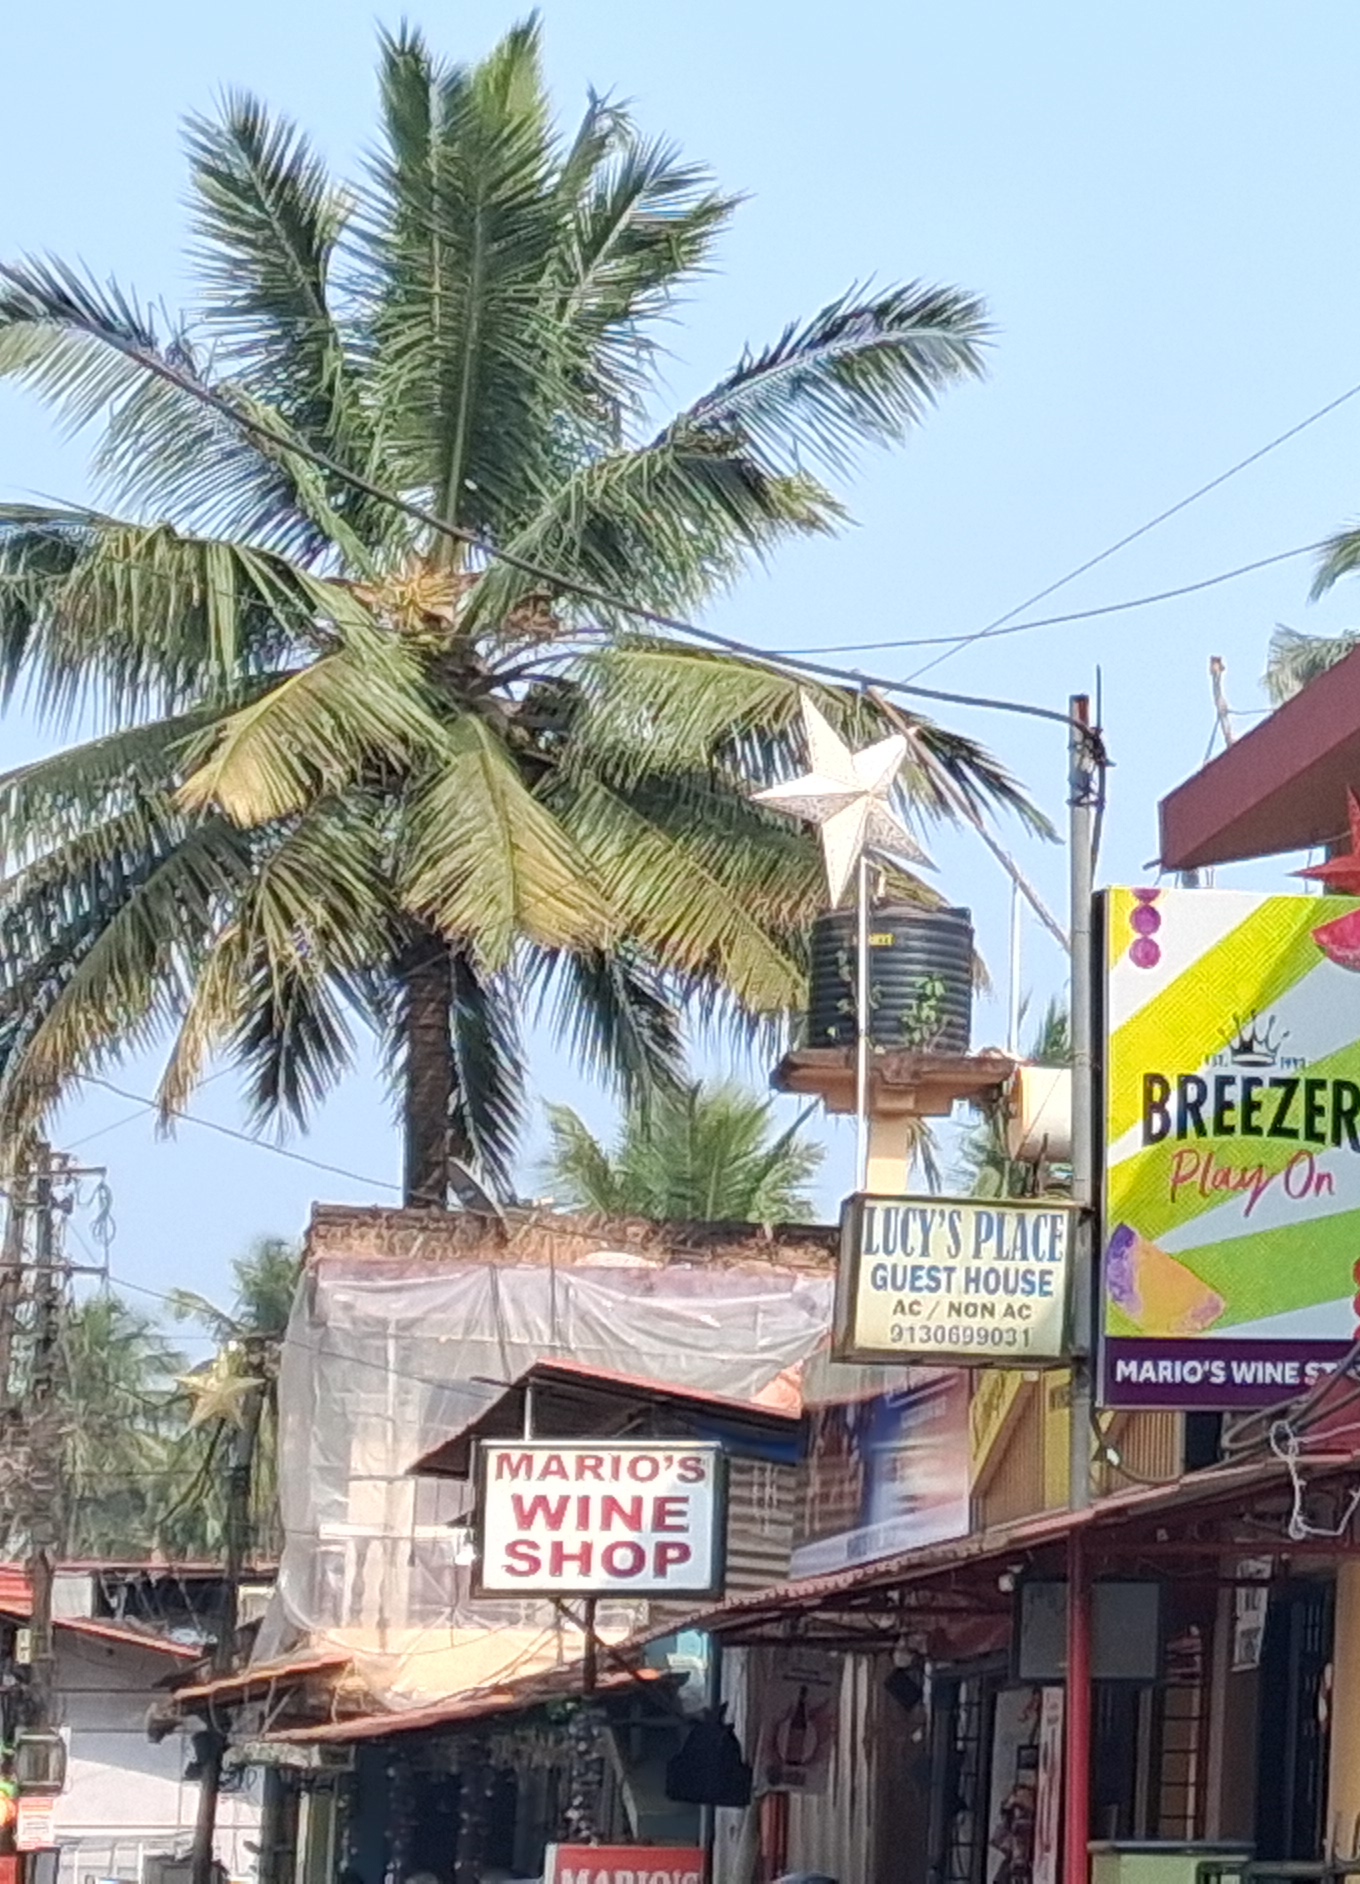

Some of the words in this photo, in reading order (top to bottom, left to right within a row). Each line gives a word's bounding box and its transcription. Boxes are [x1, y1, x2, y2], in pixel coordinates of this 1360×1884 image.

[1168, 1148, 1277, 1217] Play
[1283, 1149, 1336, 1199] On
[863, 1206, 962, 1259] LUCY'S
[972, 1210, 1064, 1262] PLACE
[870, 1263, 957, 1293] GUEST
[963, 1266, 1054, 1298] HOUSE
[892, 1300, 923, 1316] AC
[947, 1302, 996, 1319] NON
[1002, 1303, 1033, 1321] AC
[1116, 1359, 1227, 1384] MARIO'S
[1231, 1360, 1300, 1386] WINE
[495, 1452, 706, 1483] MARIO'S
[511, 1494, 691, 1533] WINE
[502, 1538, 693, 1579] SHOP
